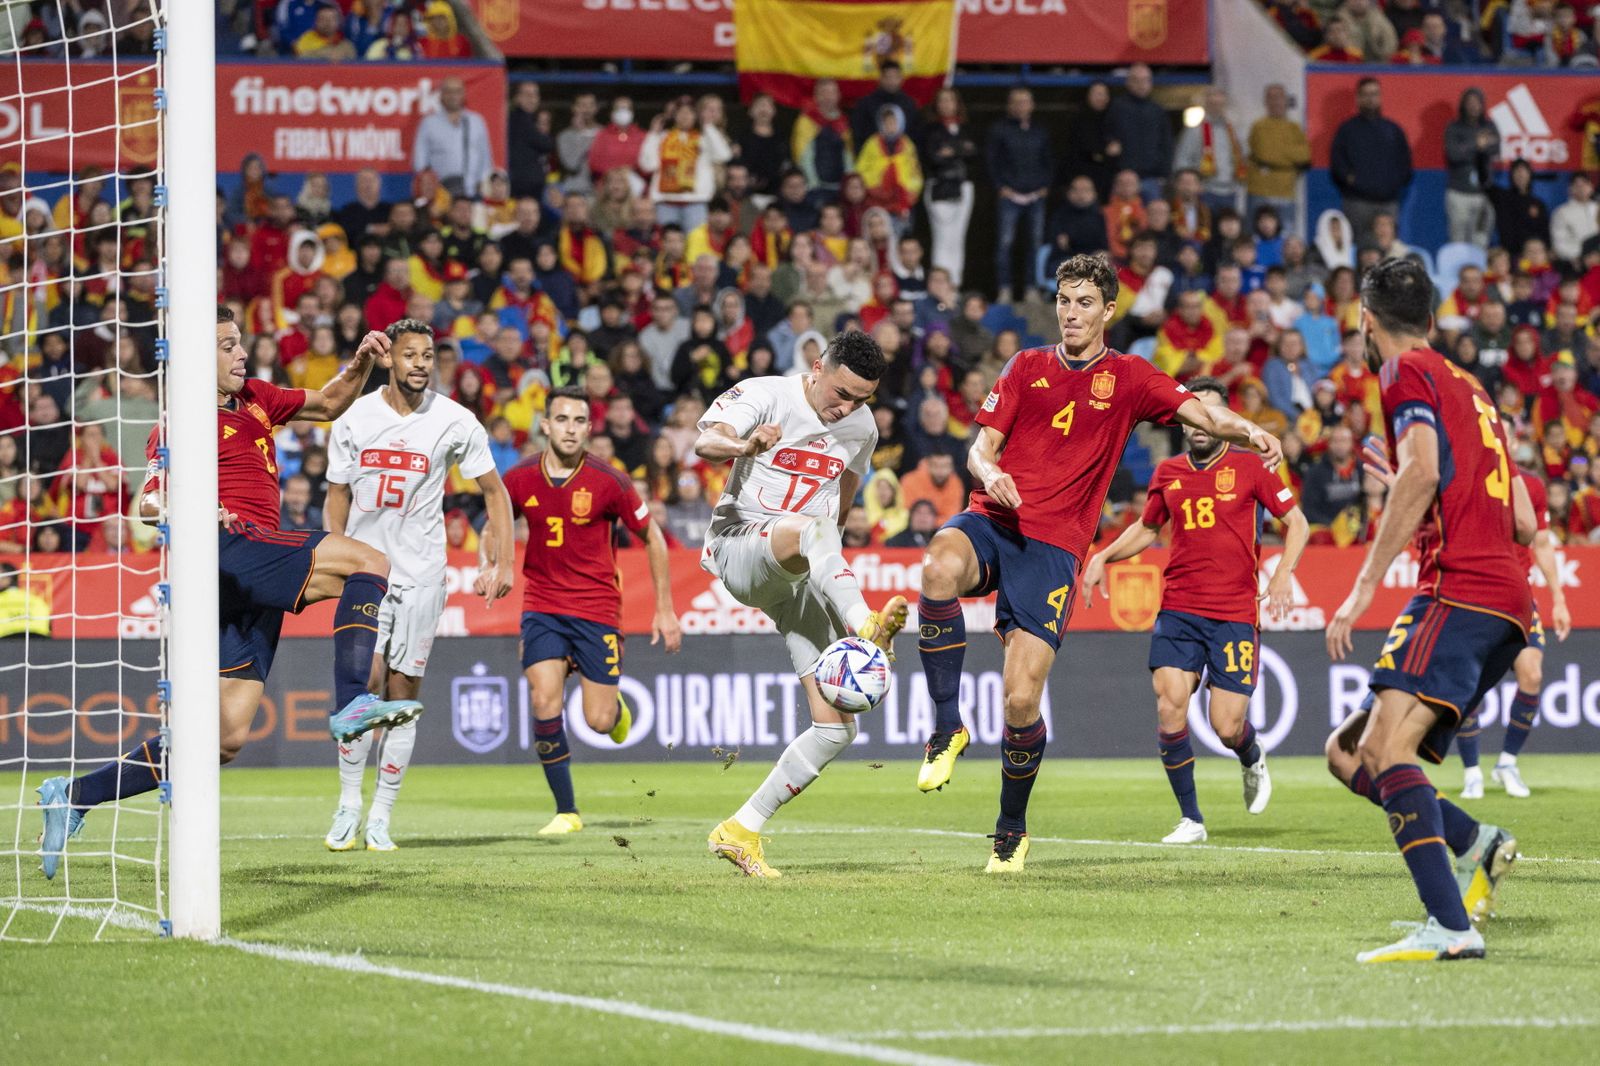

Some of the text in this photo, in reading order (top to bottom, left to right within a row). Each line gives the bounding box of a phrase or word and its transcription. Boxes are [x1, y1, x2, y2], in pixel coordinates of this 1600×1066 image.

[231, 76, 443, 116] finetwork
[274, 127, 329, 160] FIBRA
[331, 127, 345, 160] Y
[1051, 400, 1076, 436] 4
[376, 474, 406, 508] 15
[781, 474, 821, 513] 17
[1181, 496, 1216, 530] 18
[545, 516, 564, 547] 3
[1047, 584, 1069, 619] 4
[603, 633, 619, 664] 3
[1381, 615, 1414, 656] 5
[1222, 640, 1254, 672] 18
[563, 673, 802, 749] OURMET
